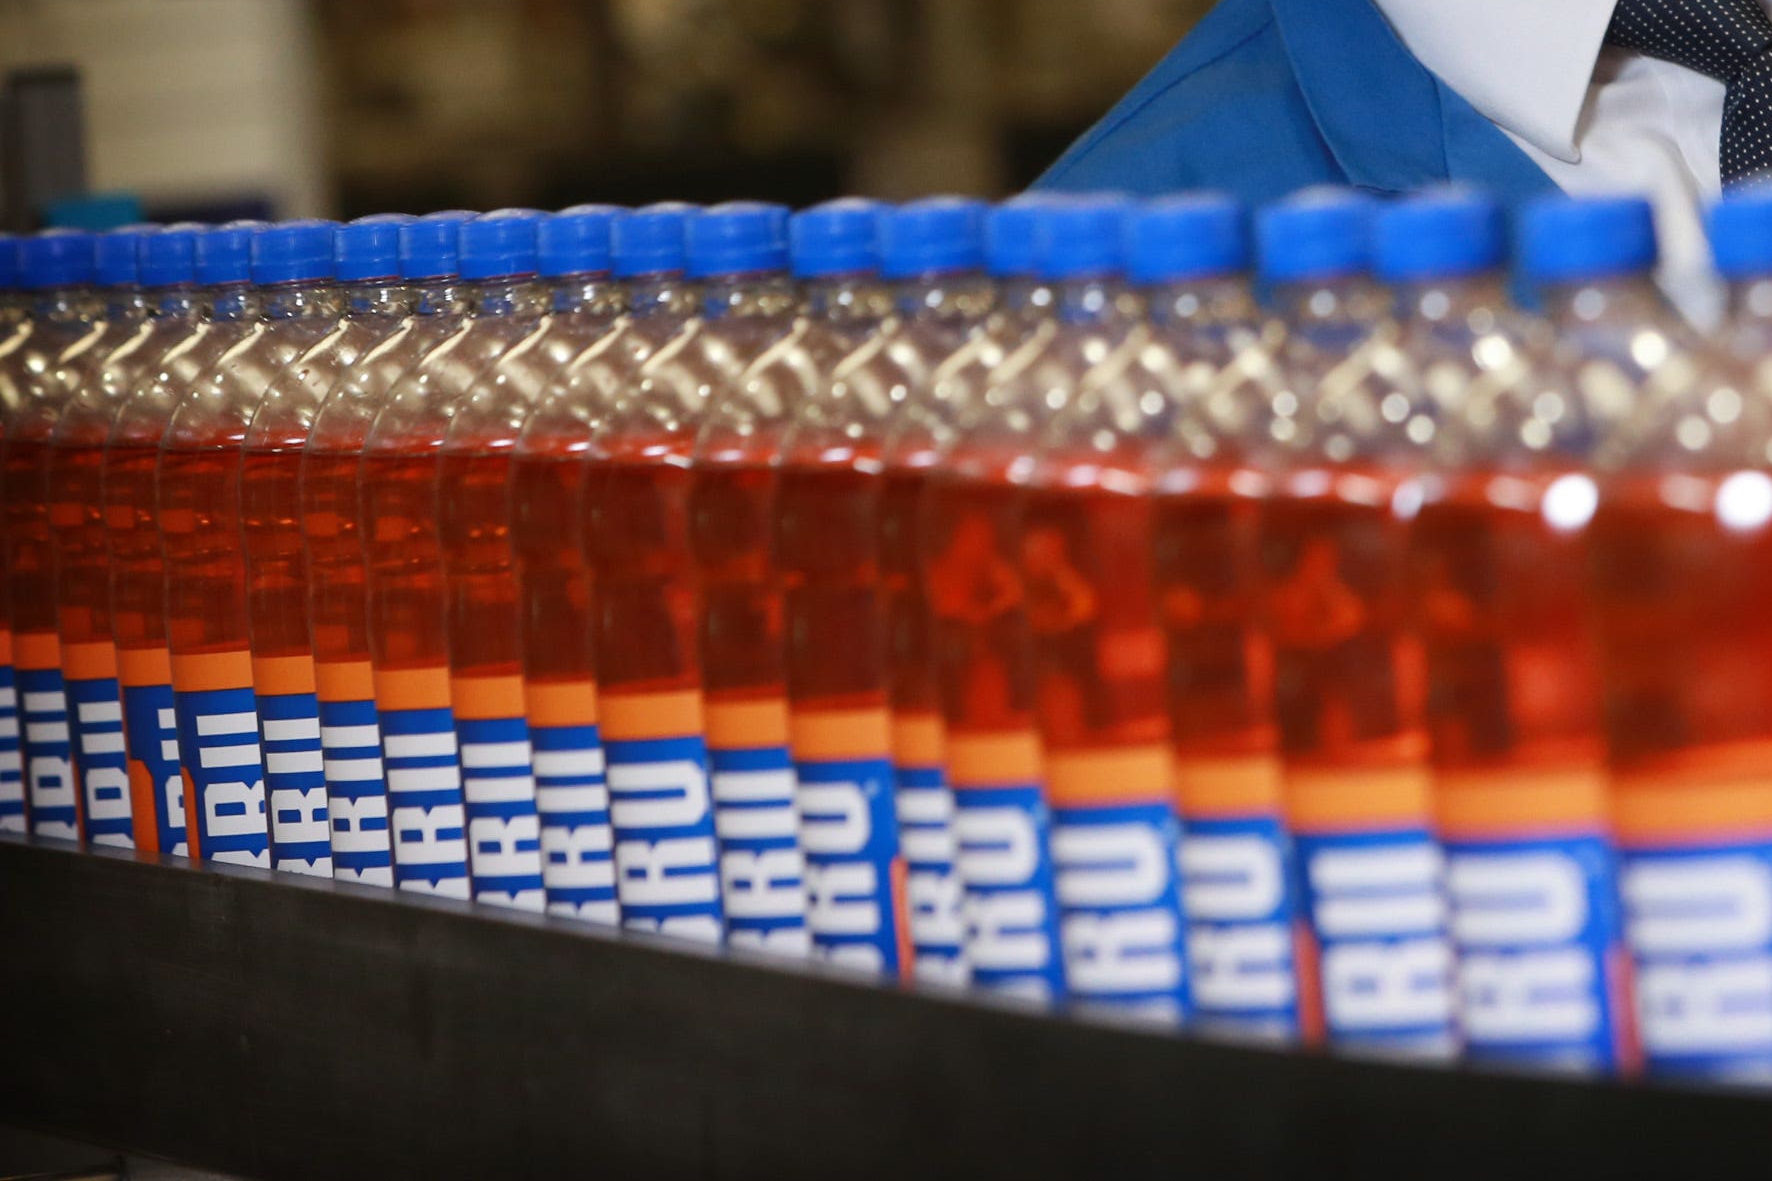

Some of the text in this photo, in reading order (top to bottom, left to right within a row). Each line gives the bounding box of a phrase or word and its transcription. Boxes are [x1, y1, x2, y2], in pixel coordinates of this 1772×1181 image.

[607, 760, 722, 949] RU
[1050, 823, 1181, 1022] RU
[1179, 834, 1298, 1039] RU
